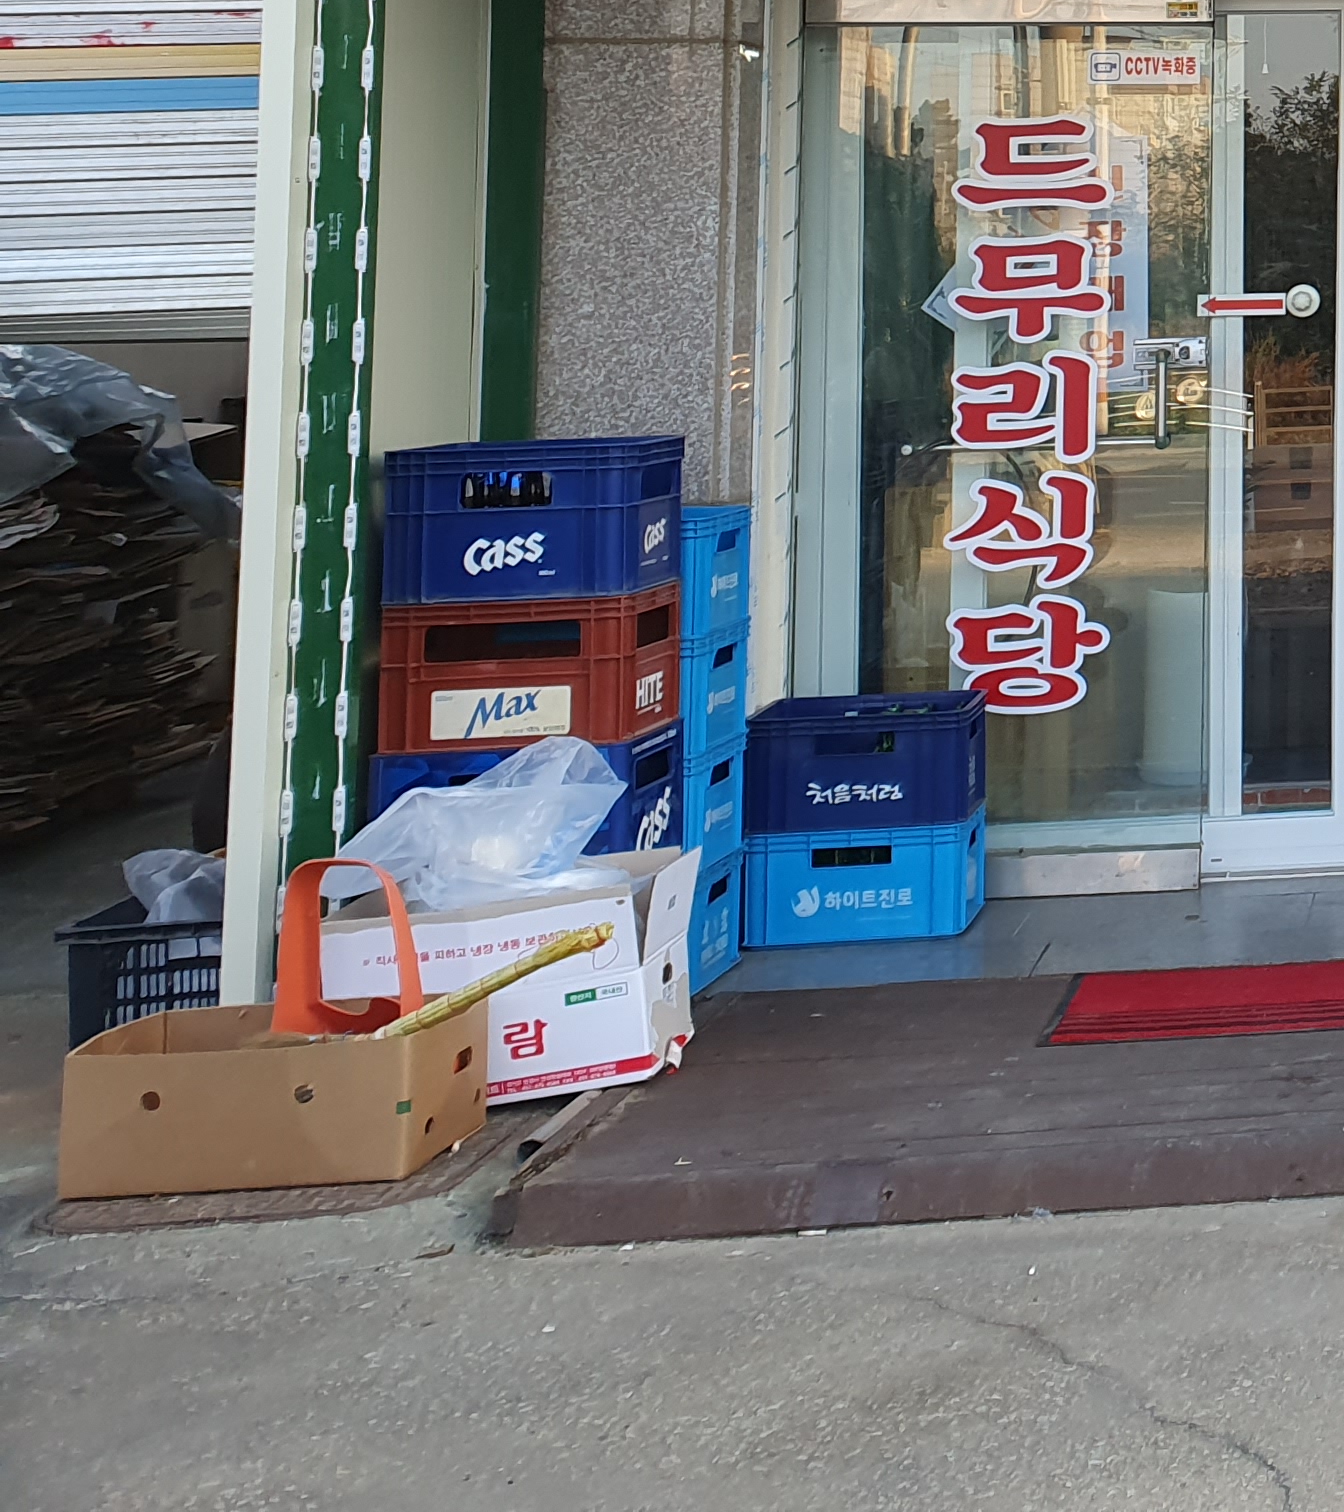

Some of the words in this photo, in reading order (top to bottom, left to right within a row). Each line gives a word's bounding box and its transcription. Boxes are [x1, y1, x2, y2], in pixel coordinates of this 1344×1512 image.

[945, 116, 1112, 714] 드무리식당
[463, 530, 547, 576] Cass
[634, 670, 664, 710] HITE
[464, 689, 542, 740] Max
[804, 782, 904, 805] 처음처럼
[823, 885, 914, 912] 하이트진로
